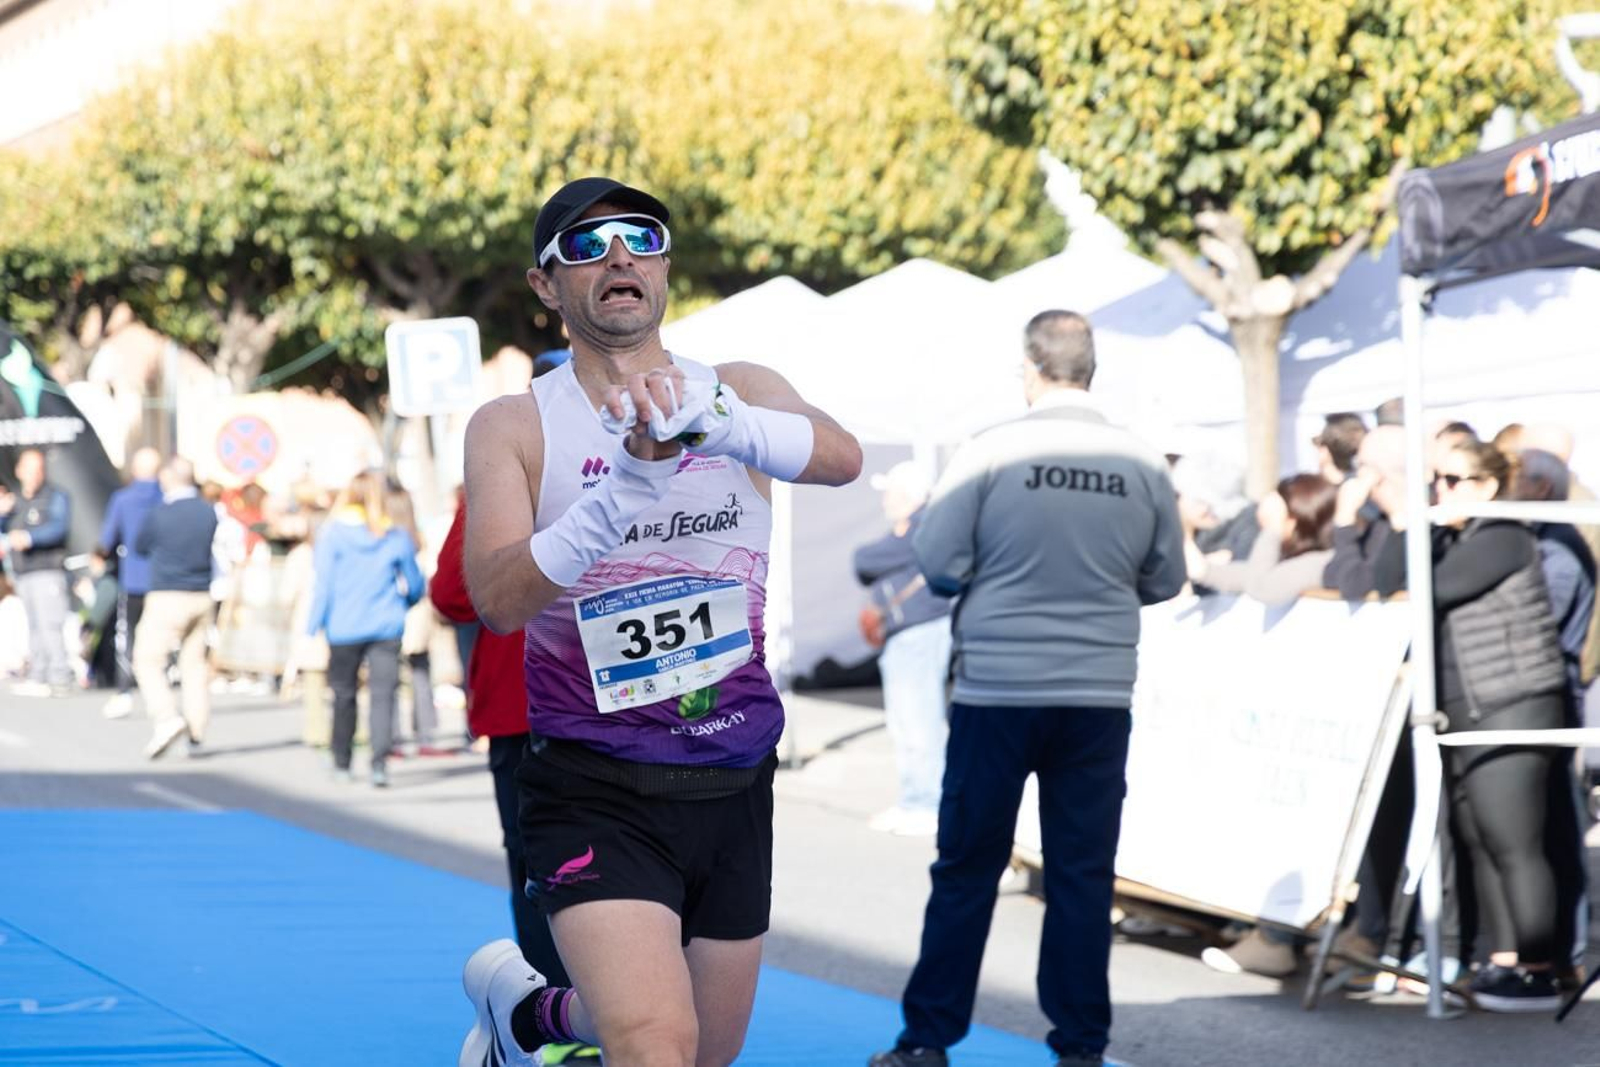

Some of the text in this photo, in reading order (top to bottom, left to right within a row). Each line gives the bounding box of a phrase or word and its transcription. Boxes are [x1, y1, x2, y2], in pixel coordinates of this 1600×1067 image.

[404, 331, 464, 404] P
[642, 522, 664, 538] DE
[661, 510, 739, 542] SEGURA
[616, 601, 714, 660] 351
[655, 648, 697, 668] ANTONIO
